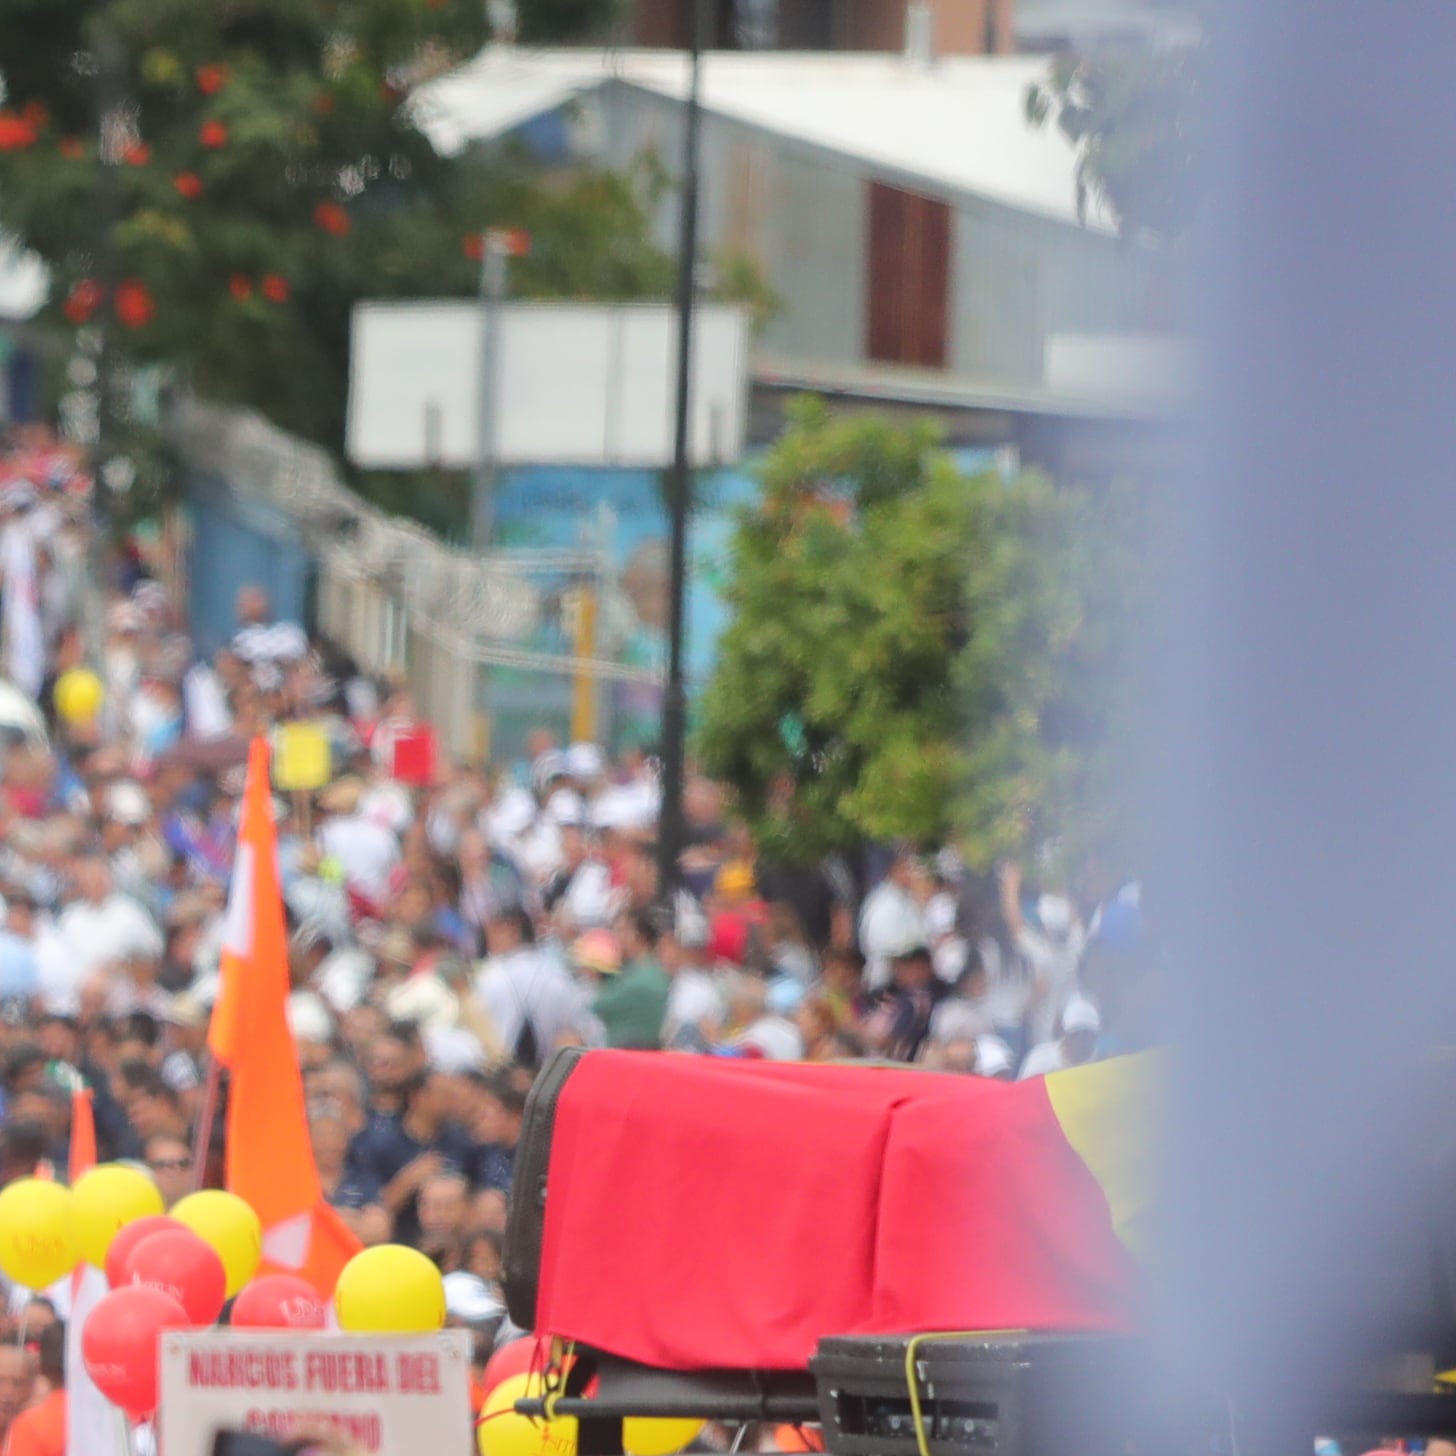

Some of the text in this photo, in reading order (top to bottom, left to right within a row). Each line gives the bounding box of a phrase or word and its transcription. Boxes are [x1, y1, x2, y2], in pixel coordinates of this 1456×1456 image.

[189, 1350, 442, 1393] NARCOS FUERA DEL
